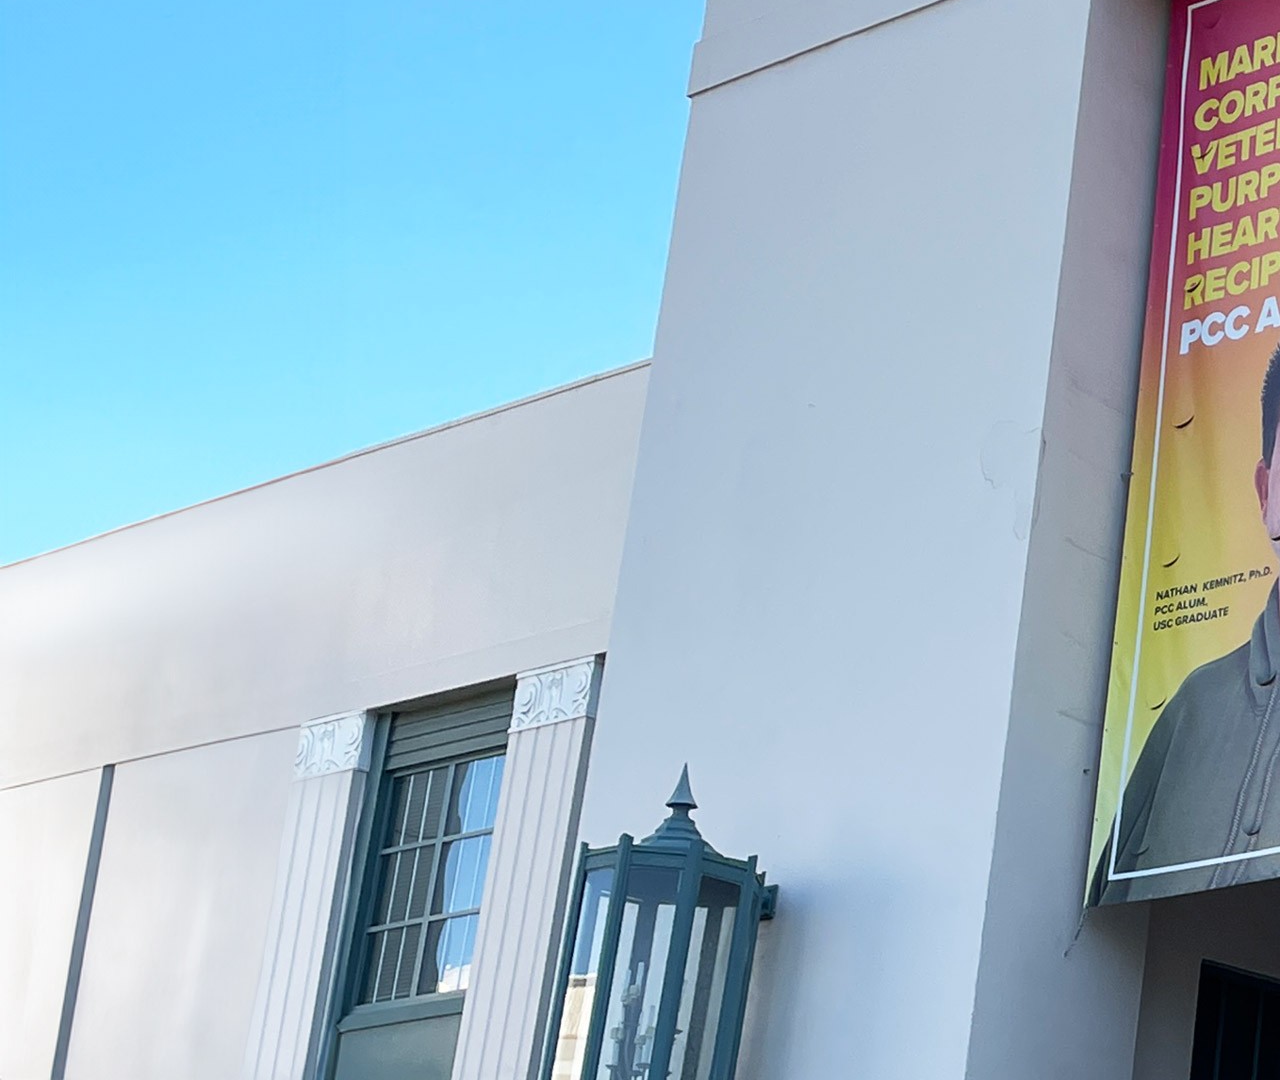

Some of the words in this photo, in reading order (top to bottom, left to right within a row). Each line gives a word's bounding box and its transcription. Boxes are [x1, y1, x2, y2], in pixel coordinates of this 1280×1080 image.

[1179, 304, 1250, 355] PCC
[1156, 583, 1198, 601] NATHAN
[1202, 572, 1247, 592] KEMNITZ,
[1248, 566, 1273, 580] Ph.D.
[1153, 616, 1174, 631] USC
[1175, 606, 1229, 626] GRADUATE
[1154, 603, 1174, 616] PCC
